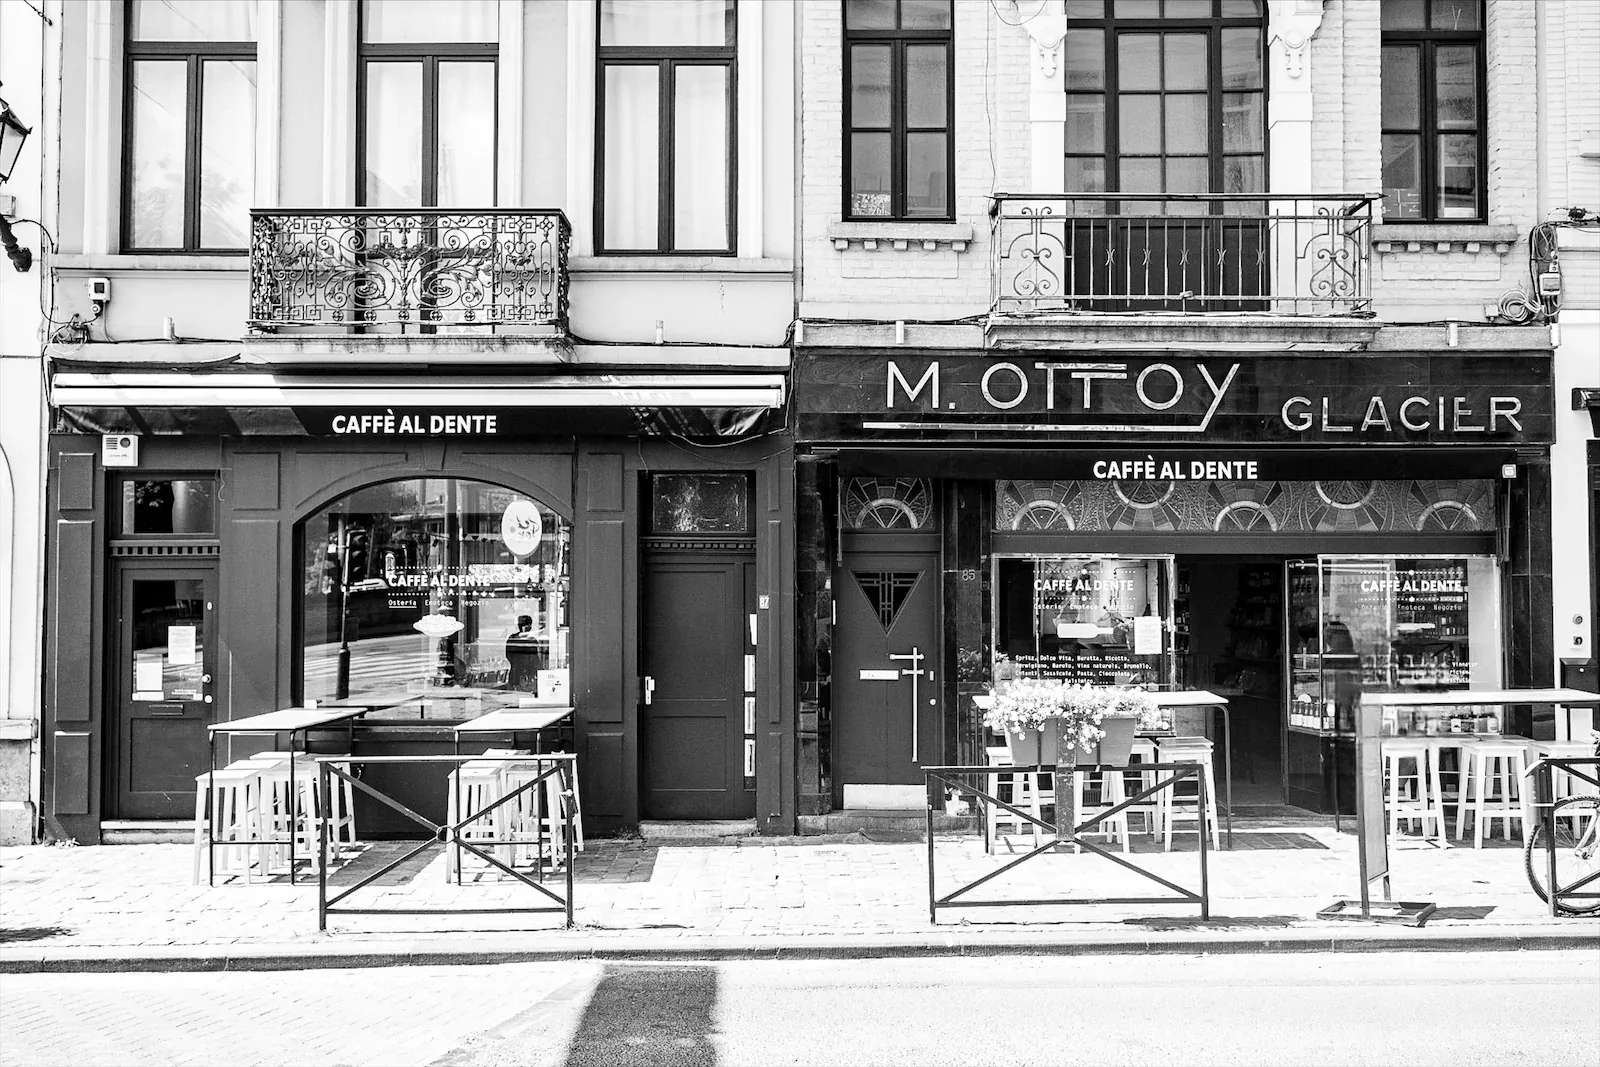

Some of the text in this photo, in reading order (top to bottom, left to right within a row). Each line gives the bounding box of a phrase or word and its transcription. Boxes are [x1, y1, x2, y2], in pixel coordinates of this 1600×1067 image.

[887, 361, 956, 409] M.
[332, 408, 497, 434] CAFFÈ AL DENTE
[1281, 396, 1524, 432] GLACIER
[1093, 455, 1258, 480] CAFFÈ AL DENTE
[388, 571, 490, 587] CAFFÈ AL DENTE
[962, 569, 976, 581] 85
[1033, 576, 1134, 591] CAFFÈ AL DENTE
[1360, 576, 1462, 592] CAFFÈ AL DENTE
[388, 599, 417, 607] Osteria
[424, 599, 453, 607] Enoteca
[759, 596, 770, 609] 87
[1433, 604, 1462, 612] Negozio
